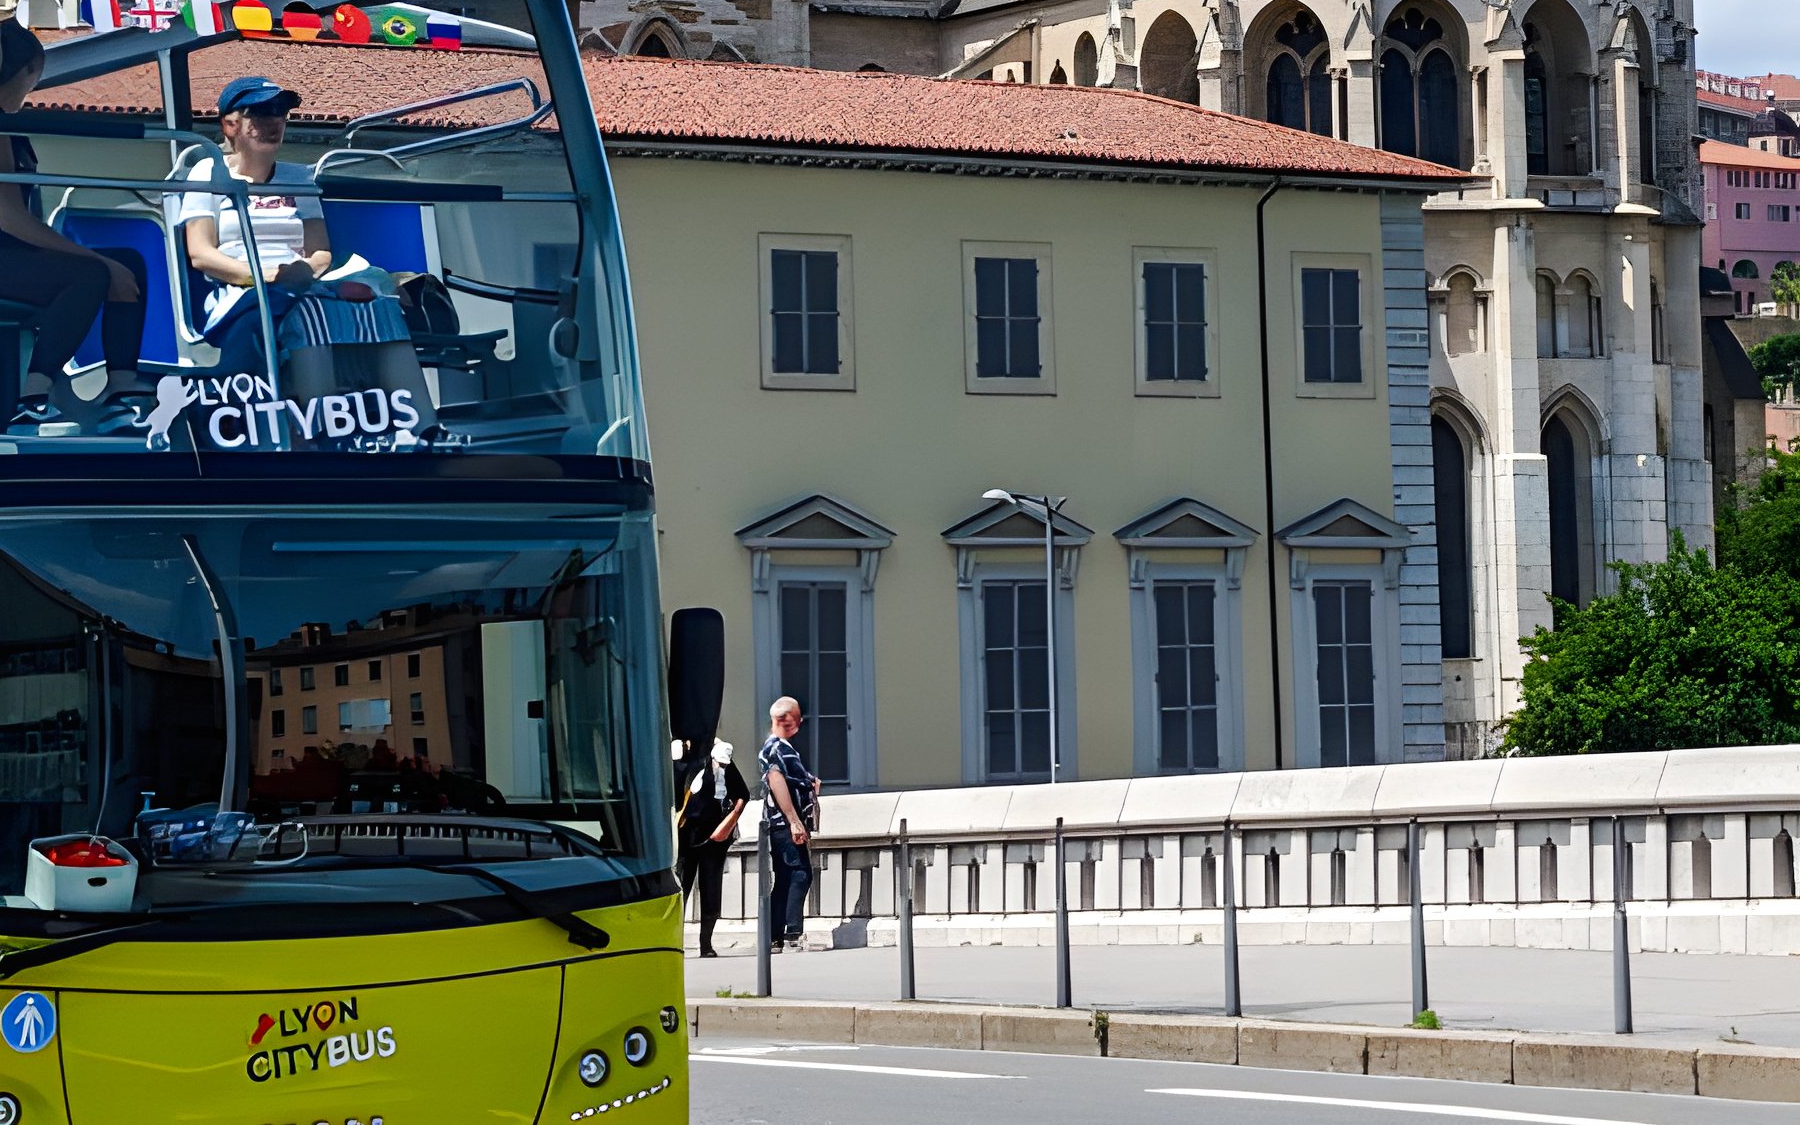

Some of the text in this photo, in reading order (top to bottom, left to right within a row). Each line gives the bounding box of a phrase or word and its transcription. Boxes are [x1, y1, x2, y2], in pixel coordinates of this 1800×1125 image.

[197, 373, 276, 406] LYON
[208, 388, 420, 448] CITYBUS
[279, 996, 359, 1037] LYON
[246, 1026, 397, 1082] CITYBUS
